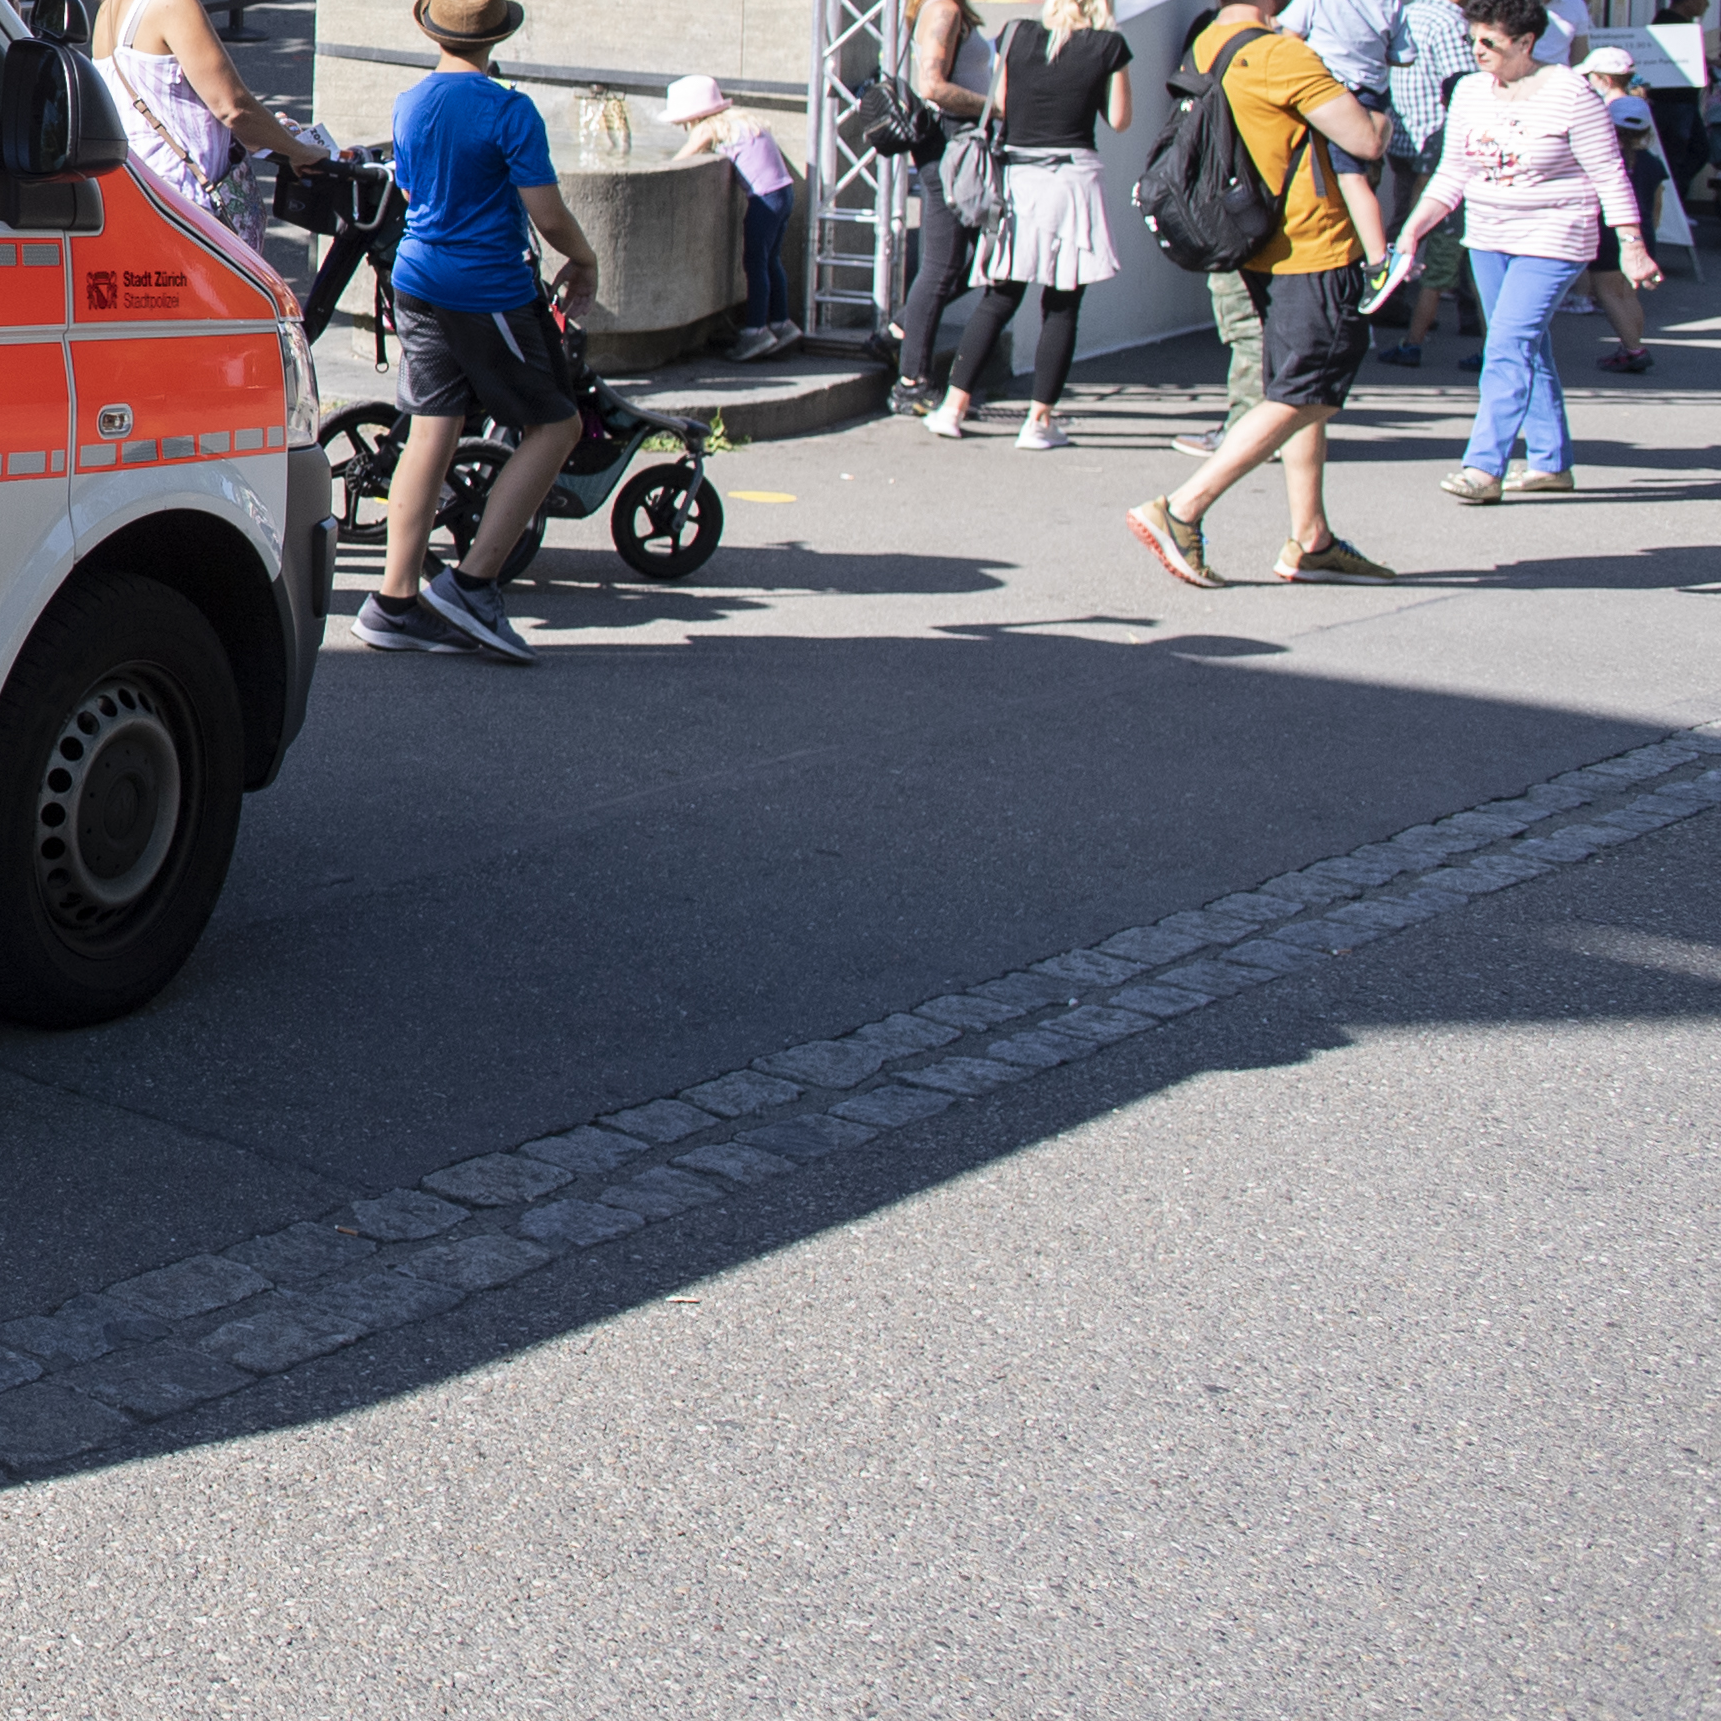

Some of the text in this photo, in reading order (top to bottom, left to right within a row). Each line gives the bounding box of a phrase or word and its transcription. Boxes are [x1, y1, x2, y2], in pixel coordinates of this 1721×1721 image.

[123, 270, 188, 287] Stadt Zürich
[123, 292, 180, 310] Stadtpolizei
